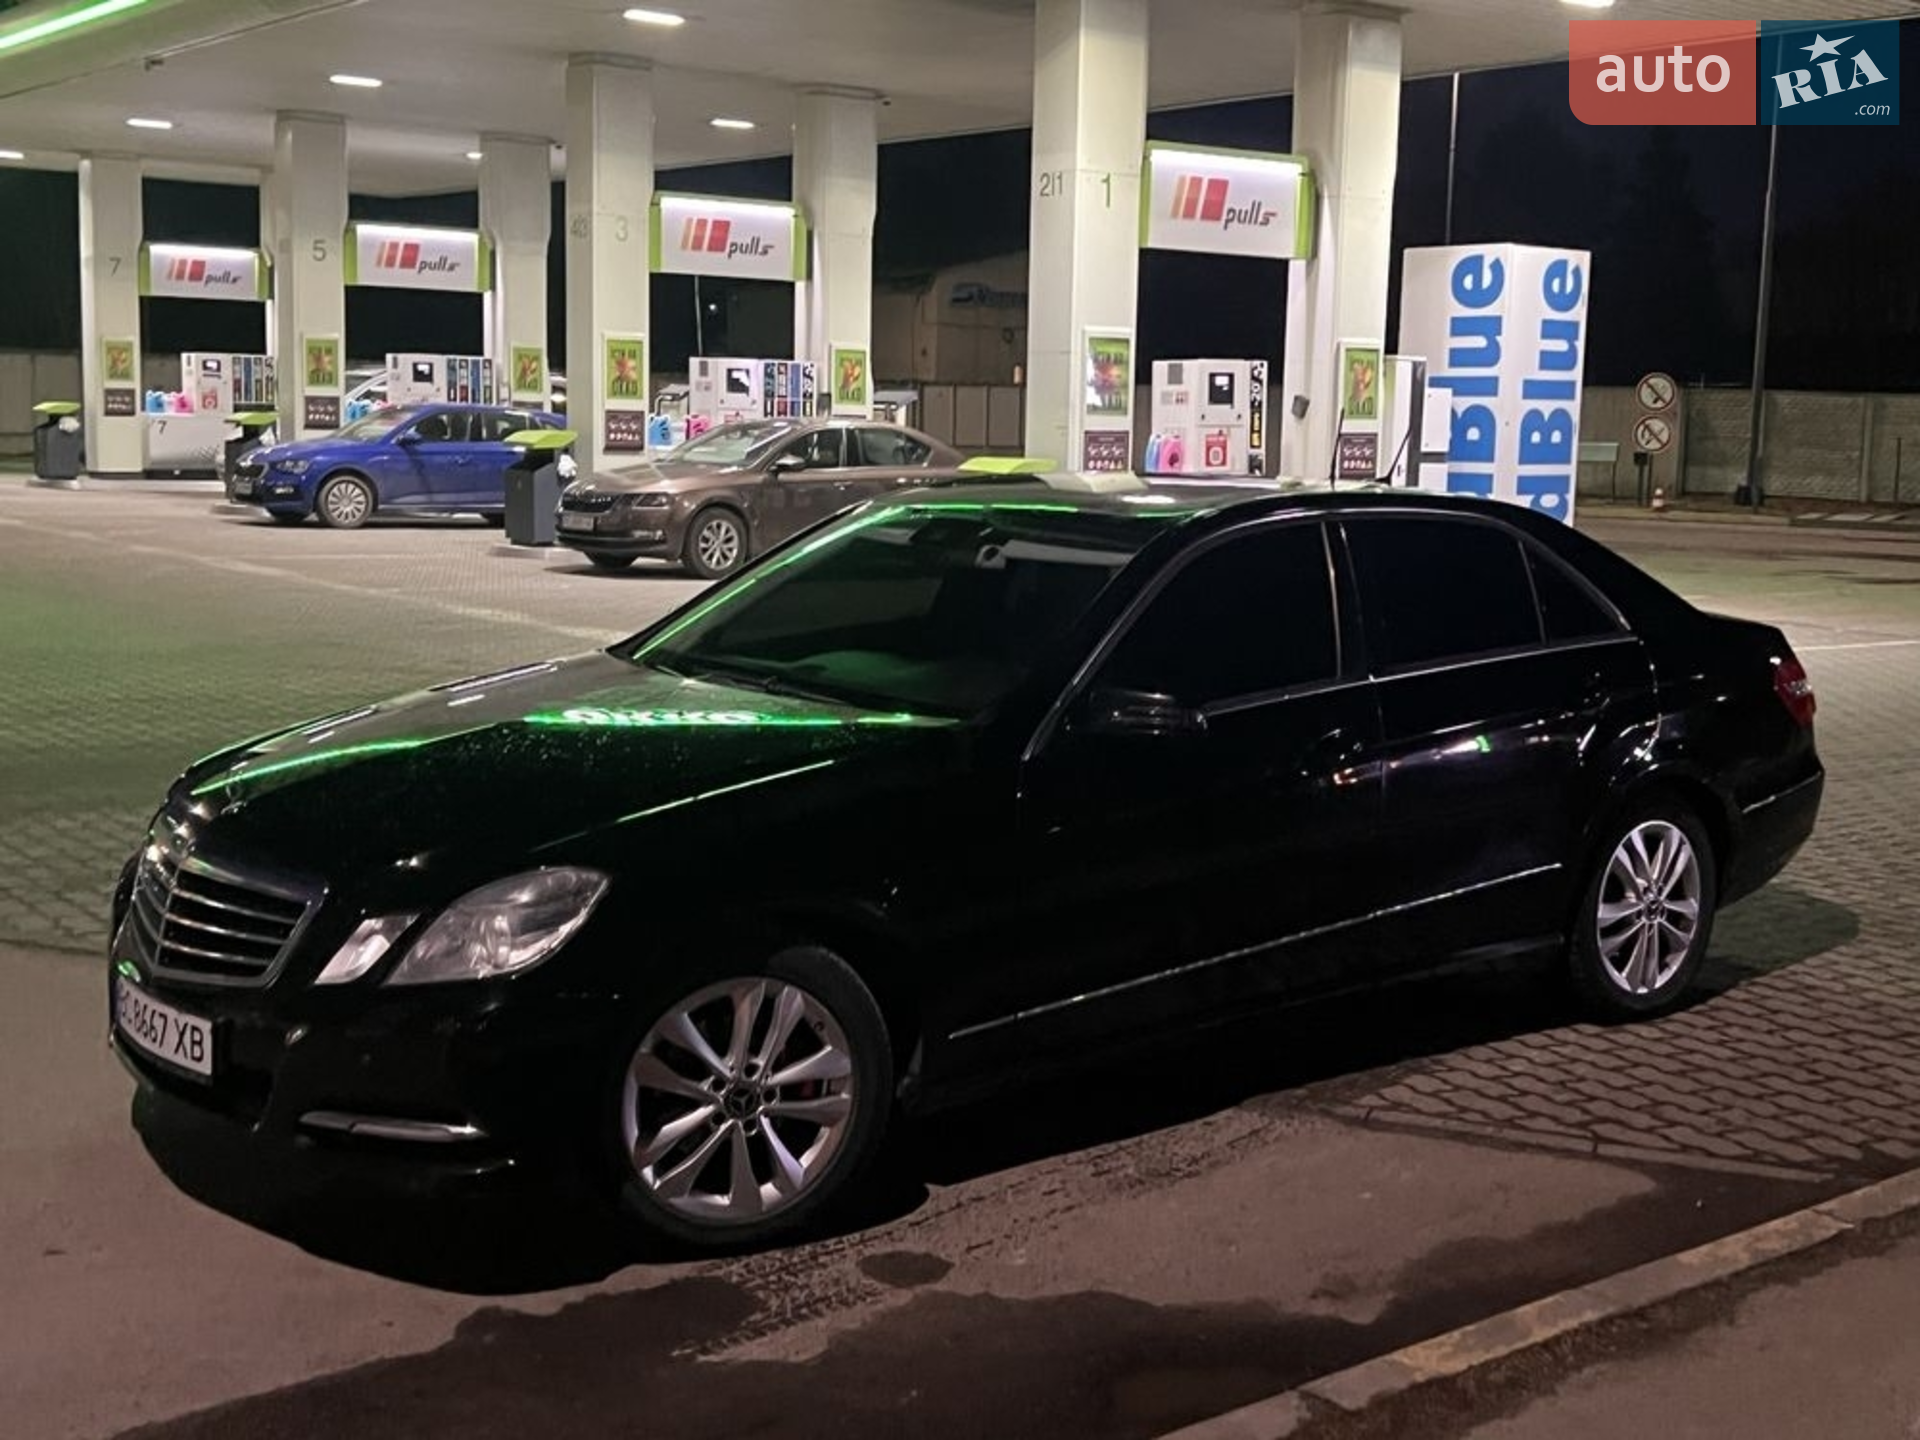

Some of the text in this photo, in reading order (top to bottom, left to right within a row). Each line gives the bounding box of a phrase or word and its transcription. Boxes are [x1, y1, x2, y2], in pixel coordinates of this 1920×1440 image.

[1101, 172, 1111, 209] 1
[615, 215, 629, 243] 3
[1223, 200, 1278, 231] pulls
[312, 239, 327, 262] 5
[727, 235, 776, 260] pulls
[109, 256, 122, 278] 7
[173, 1016, 205, 1063] XB
